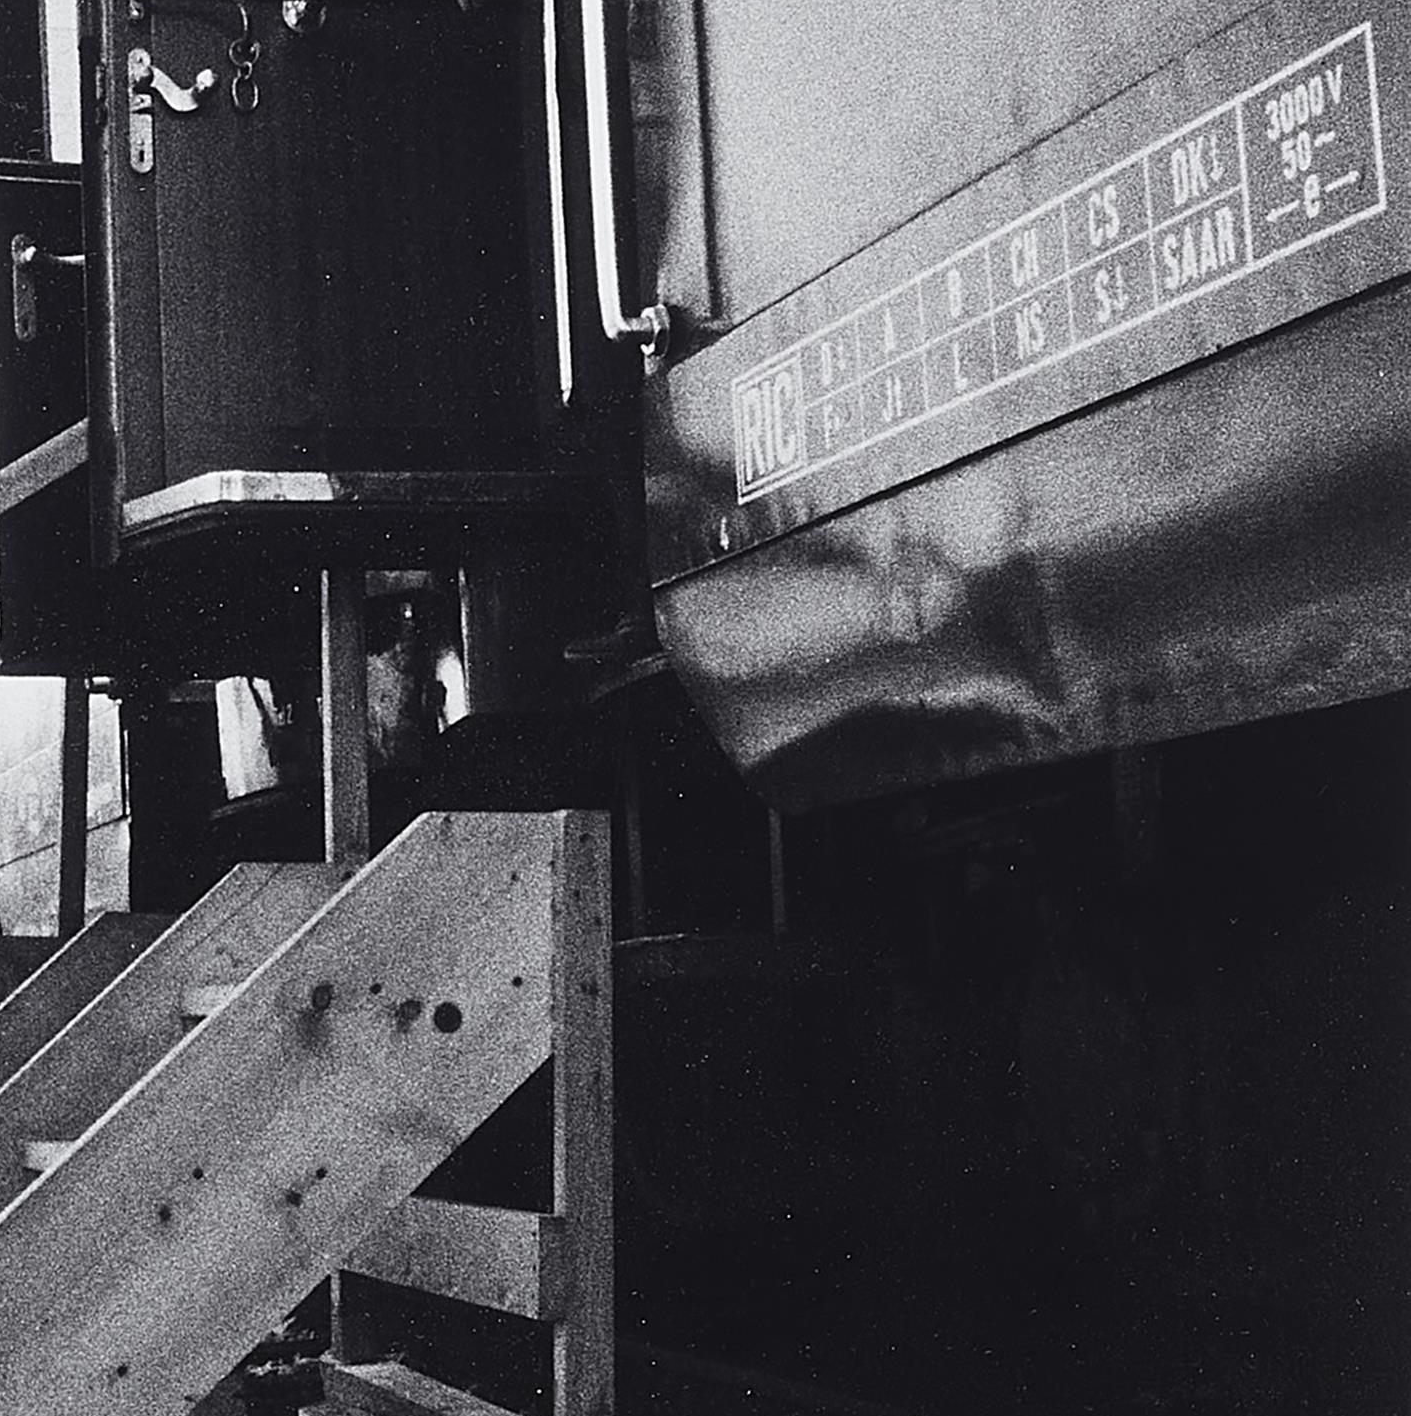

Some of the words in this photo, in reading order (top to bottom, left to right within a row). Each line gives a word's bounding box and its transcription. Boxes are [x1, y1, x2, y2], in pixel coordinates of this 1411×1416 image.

[1264, 62, 1344, 142] 3000V
[1089, 184, 1121, 247] CS
[1163, 205, 1236, 290] SAAR
[741, 370, 796, 482] RIC
